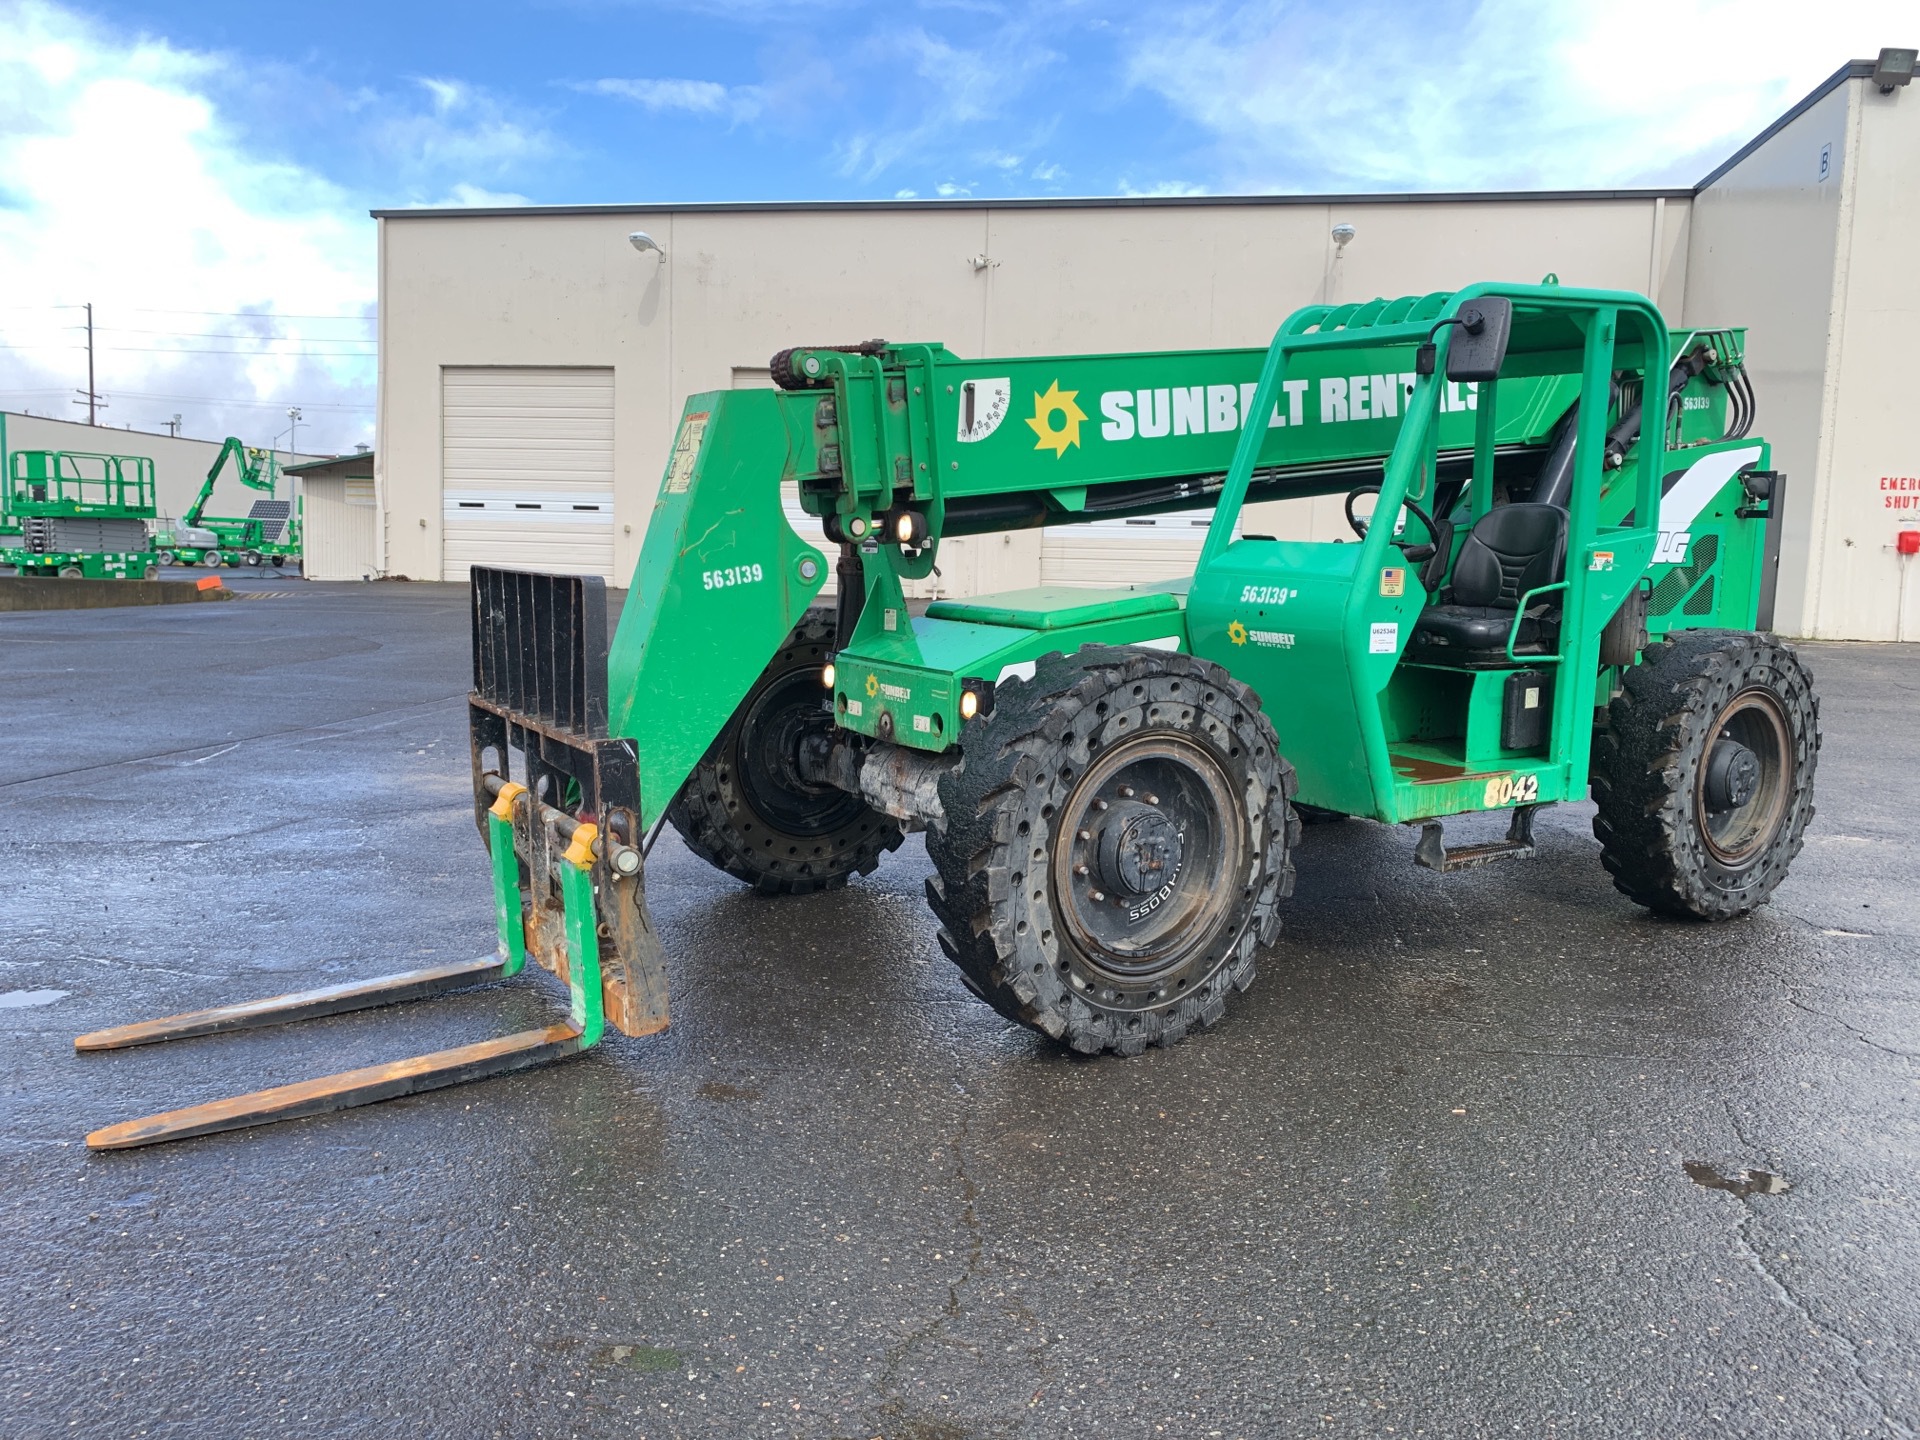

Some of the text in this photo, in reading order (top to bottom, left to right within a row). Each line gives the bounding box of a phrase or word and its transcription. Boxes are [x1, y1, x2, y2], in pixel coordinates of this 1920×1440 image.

[1821, 151, 1829, 173] B
[1683, 397, 1710, 410] 563139
[1885, 495, 1920, 509] SHUT
[702, 563, 763, 590] 563139
[1240, 585, 1288, 605] 563139
[1249, 630, 1295, 646] SUNBELT
[1257, 641, 1291, 650] RENTALS
[880, 683, 911, 699] SUNBELT
[1483, 773, 1539, 808] 8042
